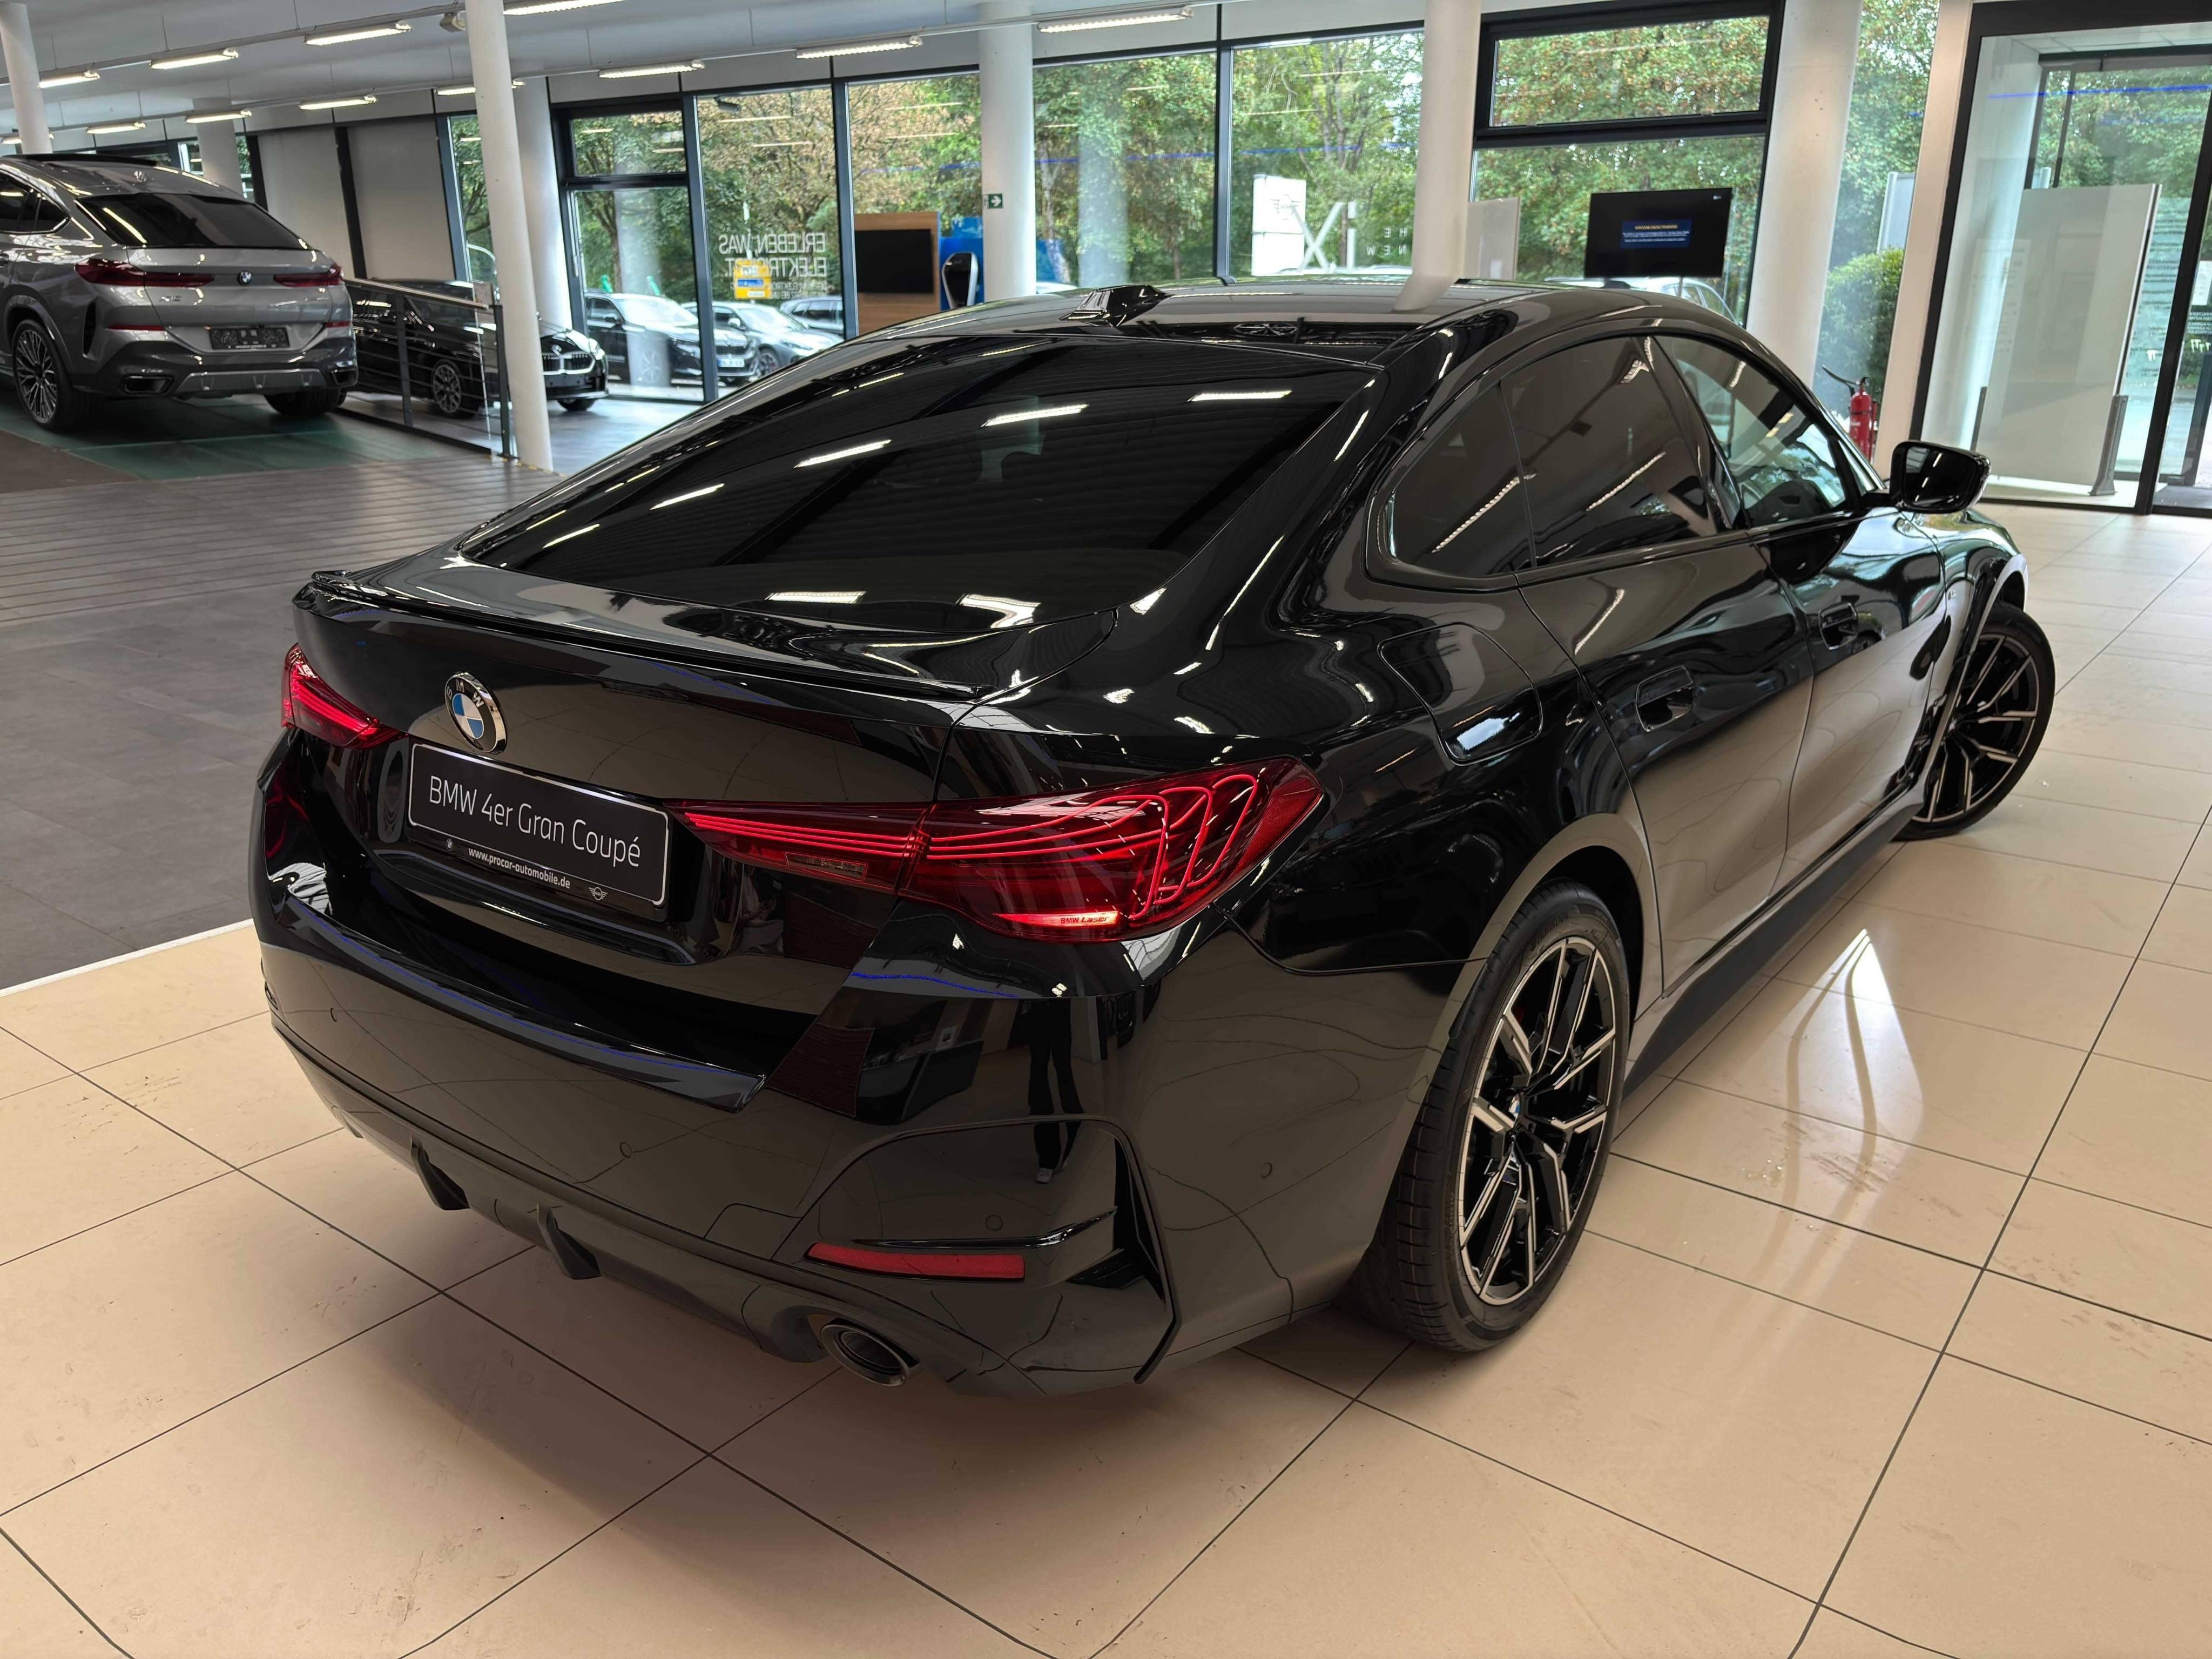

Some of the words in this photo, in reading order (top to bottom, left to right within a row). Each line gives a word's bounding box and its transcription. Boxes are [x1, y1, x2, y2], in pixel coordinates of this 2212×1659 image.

[446, 679, 485, 707] BMW
[429, 775, 477, 815] BMW
[481, 793, 514, 827] 4er
[518, 802, 564, 844] Gran
[572, 819, 640, 867] Coupé
[468, 847, 570, 889] www.procar-automobile.de
